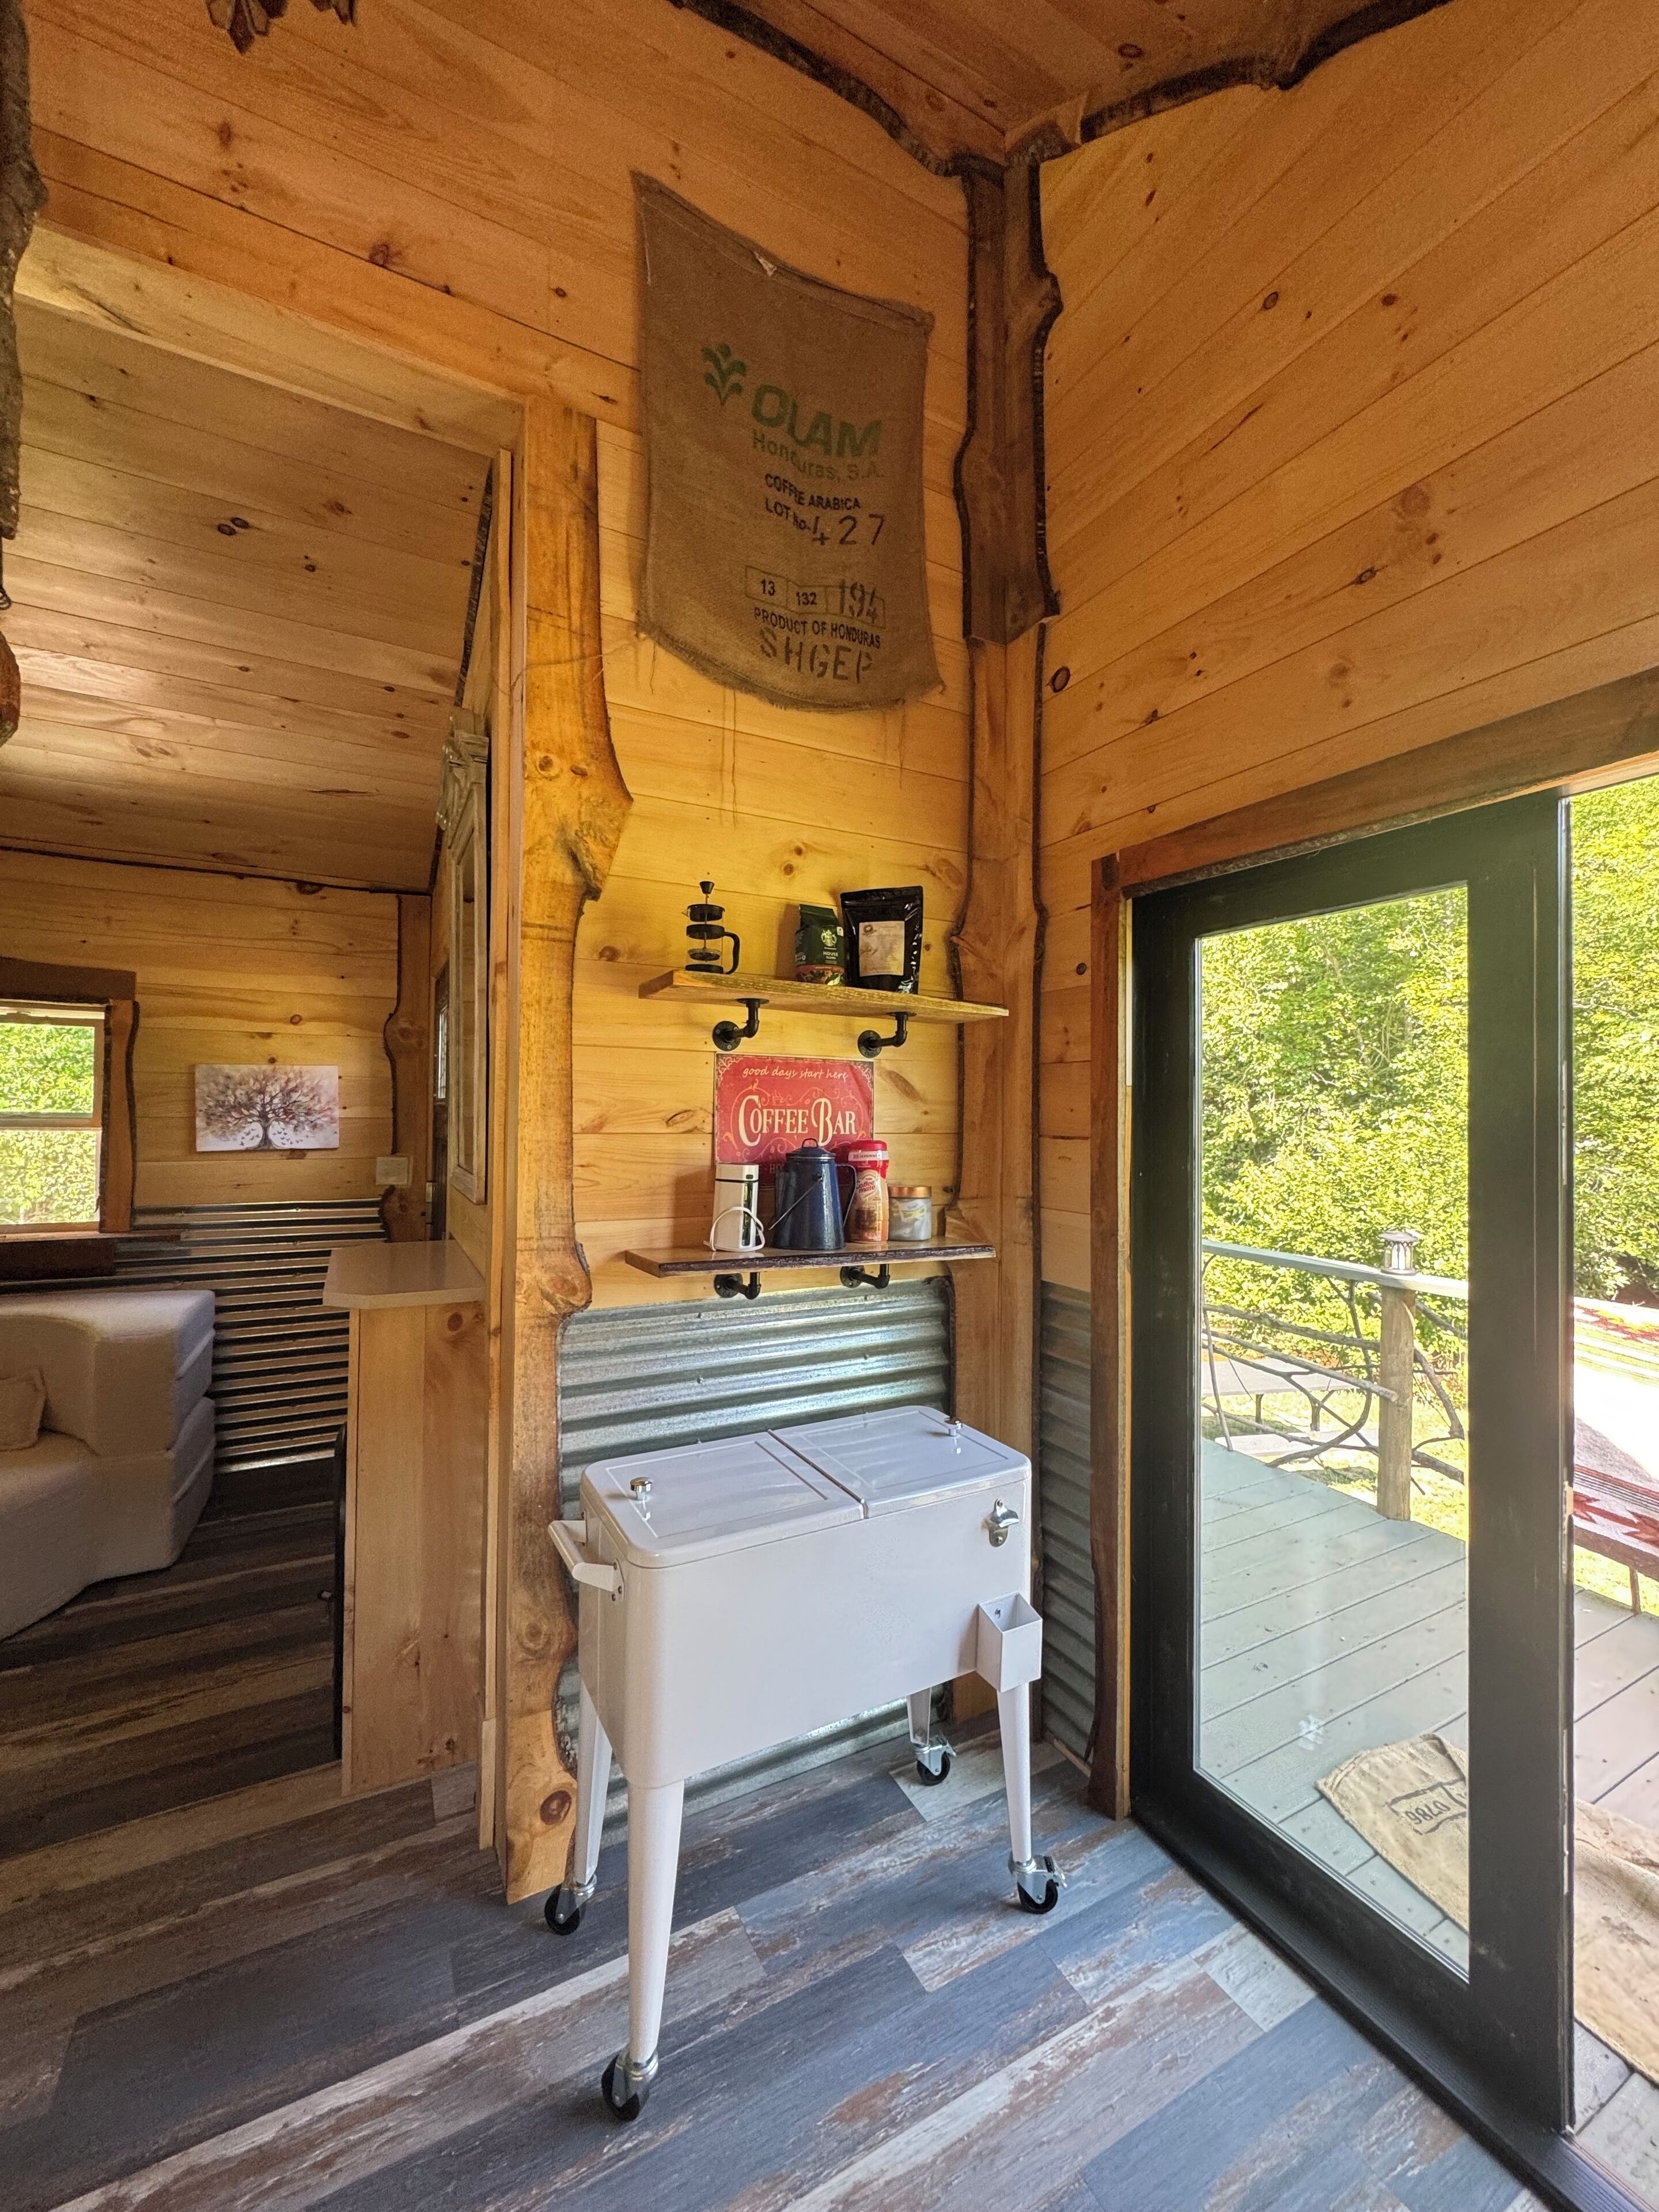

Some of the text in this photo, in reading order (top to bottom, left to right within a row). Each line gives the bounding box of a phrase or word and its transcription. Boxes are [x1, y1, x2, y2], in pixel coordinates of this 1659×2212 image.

[751, 384, 882, 457] OLAM
[764, 473, 861, 511] COFFEE ARABICA
[765, 497, 791, 519] LOT
[761, 578, 775, 596] 13
[796, 592, 817, 606] 132
[753, 607, 881, 649] PRODUCT OF HONDURAS
[742, 1066, 849, 1083] good days start here
